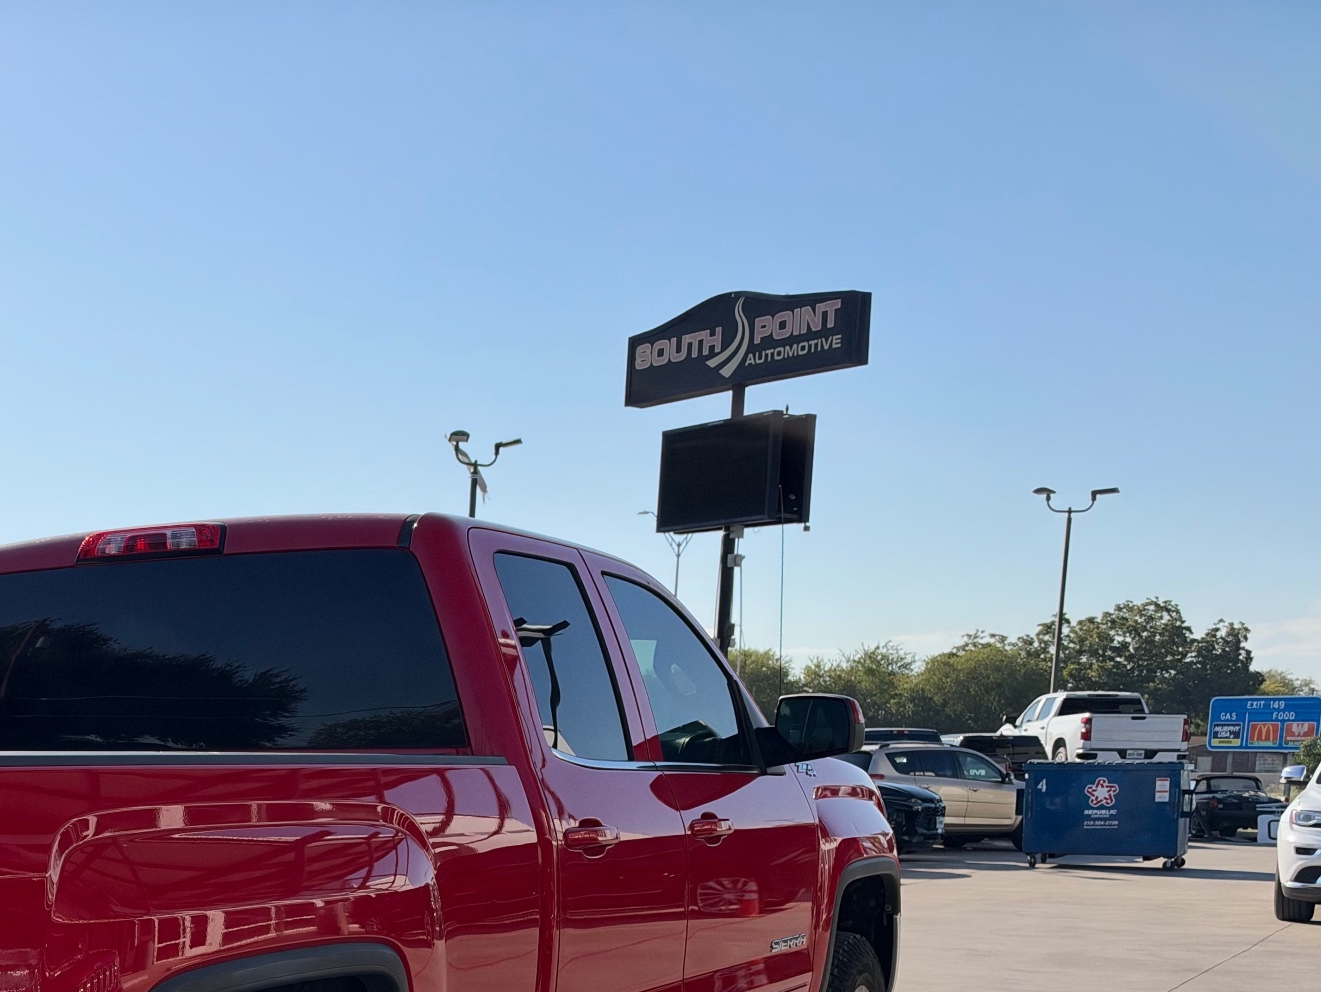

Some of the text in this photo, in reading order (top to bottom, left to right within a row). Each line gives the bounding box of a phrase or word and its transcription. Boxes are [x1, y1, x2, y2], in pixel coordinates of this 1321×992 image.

[635, 299, 842, 370] SOUTH POINT
[745, 335, 842, 366] AUTOMOTIVE
[1247, 701, 1285, 709] EXIT 149
[1220, 712, 1237, 720] GAS
[1272, 712, 1296, 720] FOOD
[1037, 778, 1047, 793] 4
[770, 933, 806, 953] SIERRA
